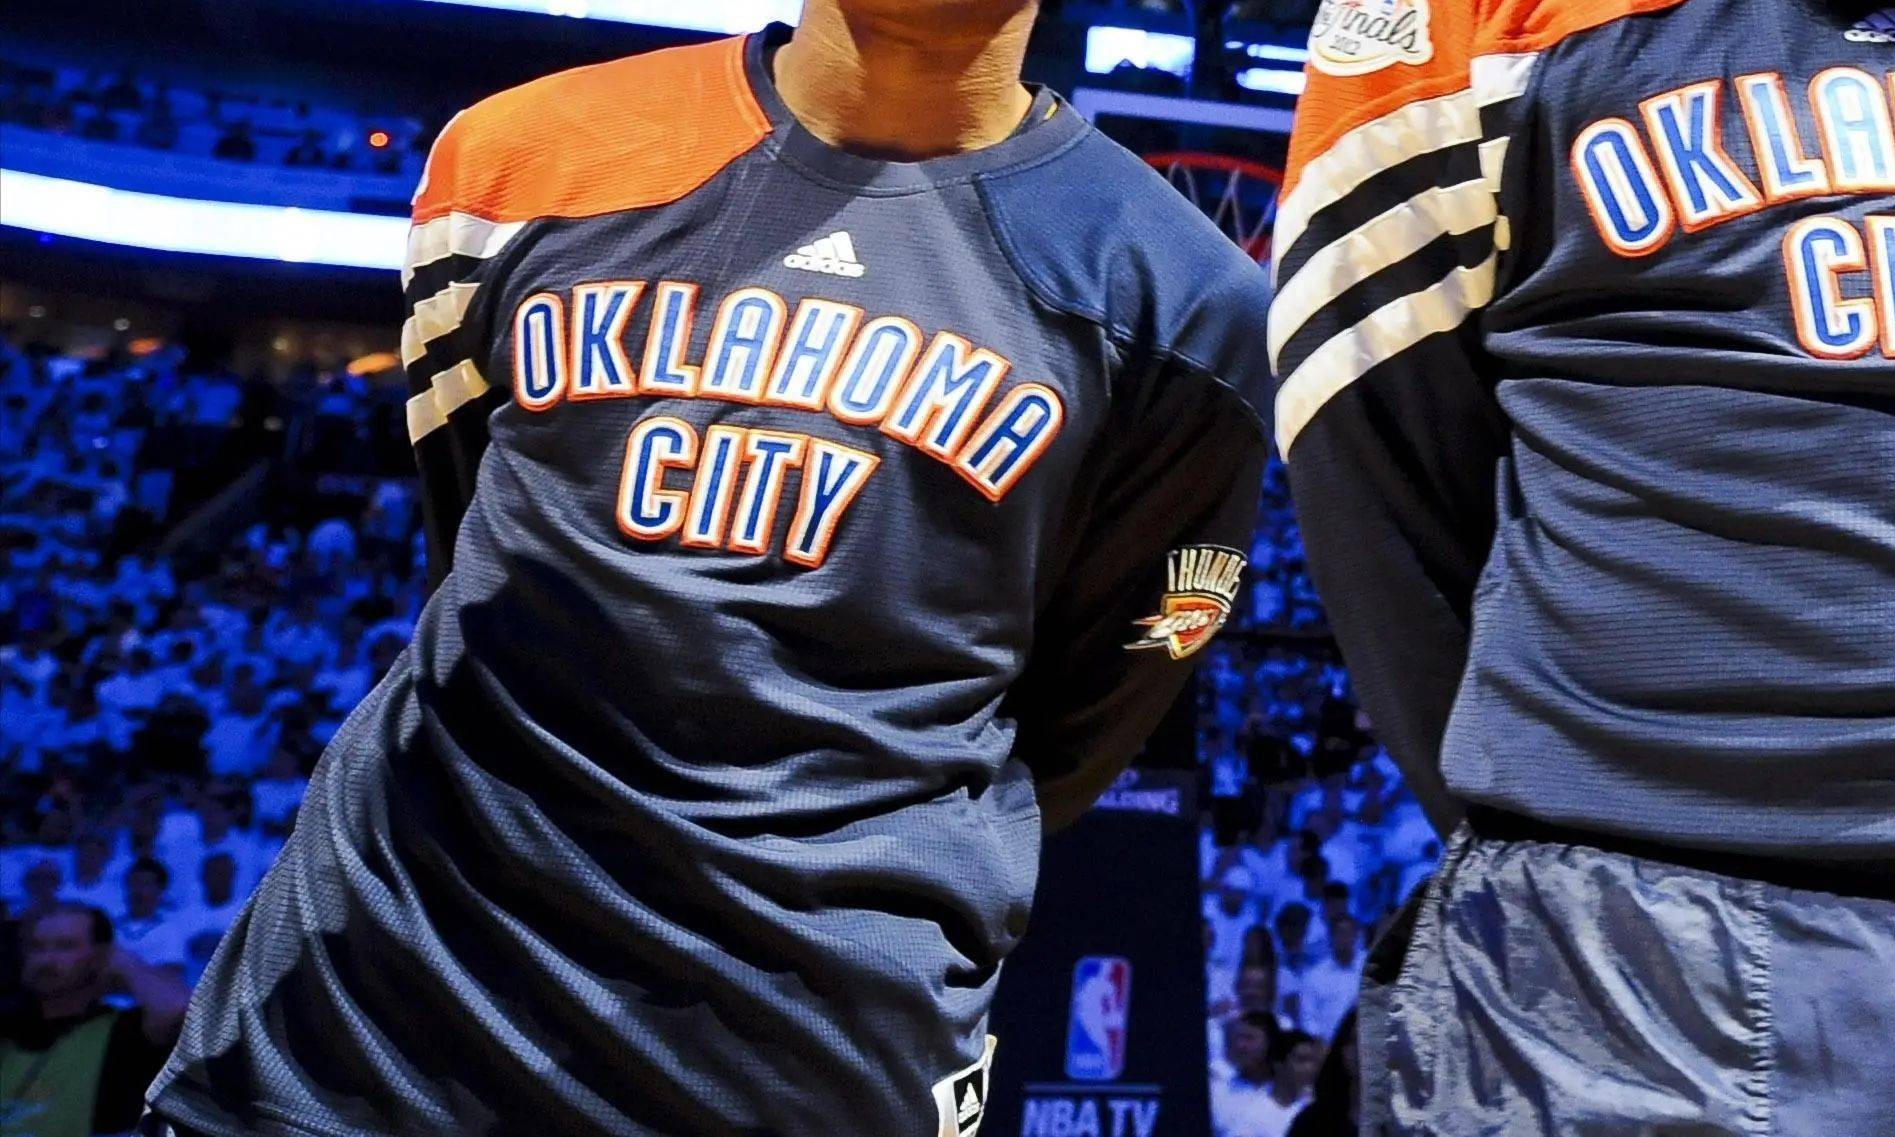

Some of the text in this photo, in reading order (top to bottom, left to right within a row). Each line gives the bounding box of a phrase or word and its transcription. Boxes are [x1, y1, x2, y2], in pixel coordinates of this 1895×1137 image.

[513, 279, 1064, 505] OKLAHOMA
[617, 415, 882, 571] CITY
[1022, 1097, 1100, 1137] NBA
[1107, 1098, 1158, 1137] TV
